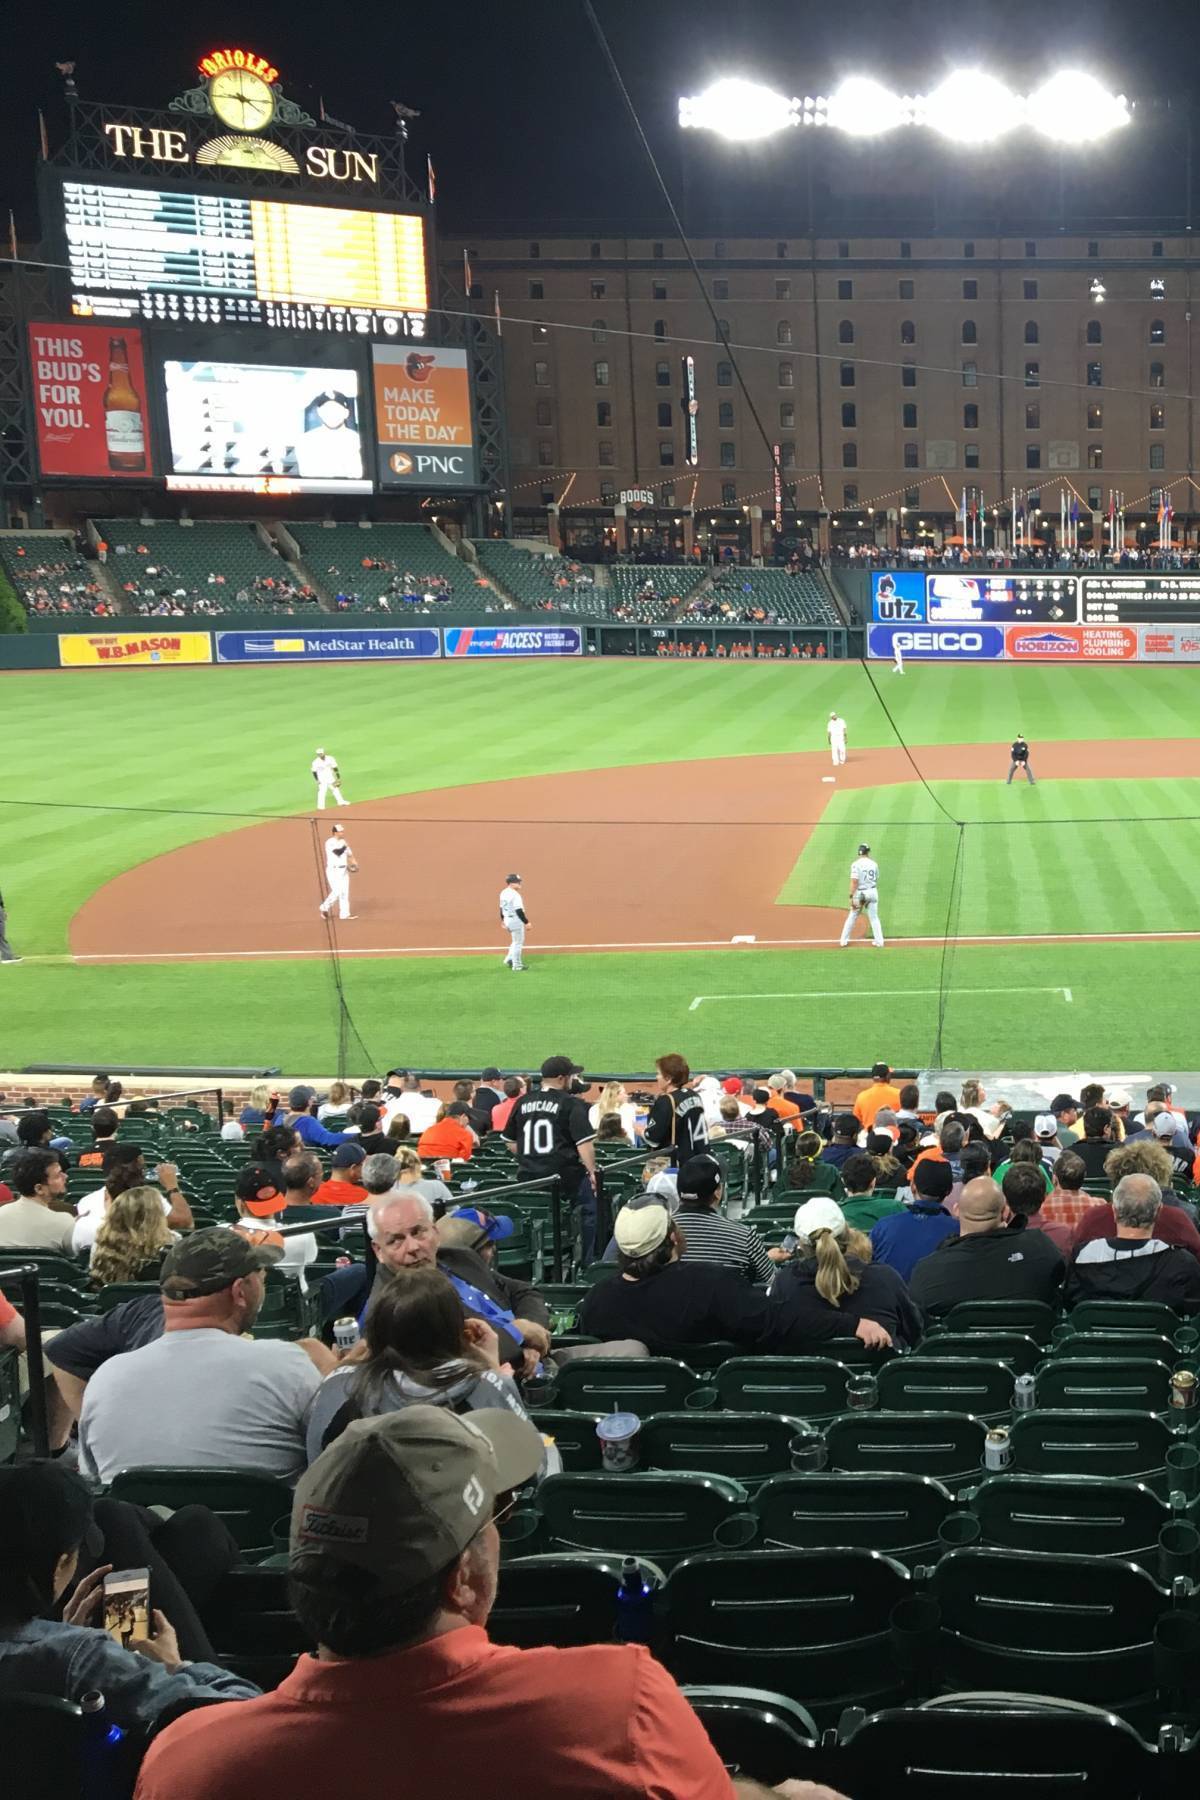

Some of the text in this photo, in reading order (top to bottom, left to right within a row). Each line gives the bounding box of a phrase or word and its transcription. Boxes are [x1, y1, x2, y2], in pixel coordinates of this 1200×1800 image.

[200, 50, 279, 83] ORIOLES
[105, 124, 378, 183] THE SUN
[34, 337, 83, 358] THIS
[38, 362, 102, 382] BUD'S
[40, 384, 81, 405] FOR
[383, 387, 436, 404] MAKE
[41, 408, 90, 428] YOU.
[384, 405, 440, 422] TODAY
[385, 424, 458, 441] THE DAY
[415, 455, 464, 474] PNC
[502, 632, 543, 649] ACCESS
[652, 630, 666, 638] 373
[892, 632, 983, 651] GEICO
[1082, 630, 1124, 639] HEATING
[308, 637, 415, 651] MedStar Health
[1016, 639, 1079, 652] HORIZON
[1082, 639, 1130, 648] PLUMBING
[1082, 647, 1124, 656] COOLING
[862, 869, 875, 881] 79
[523, 1118, 553, 1155] 10
